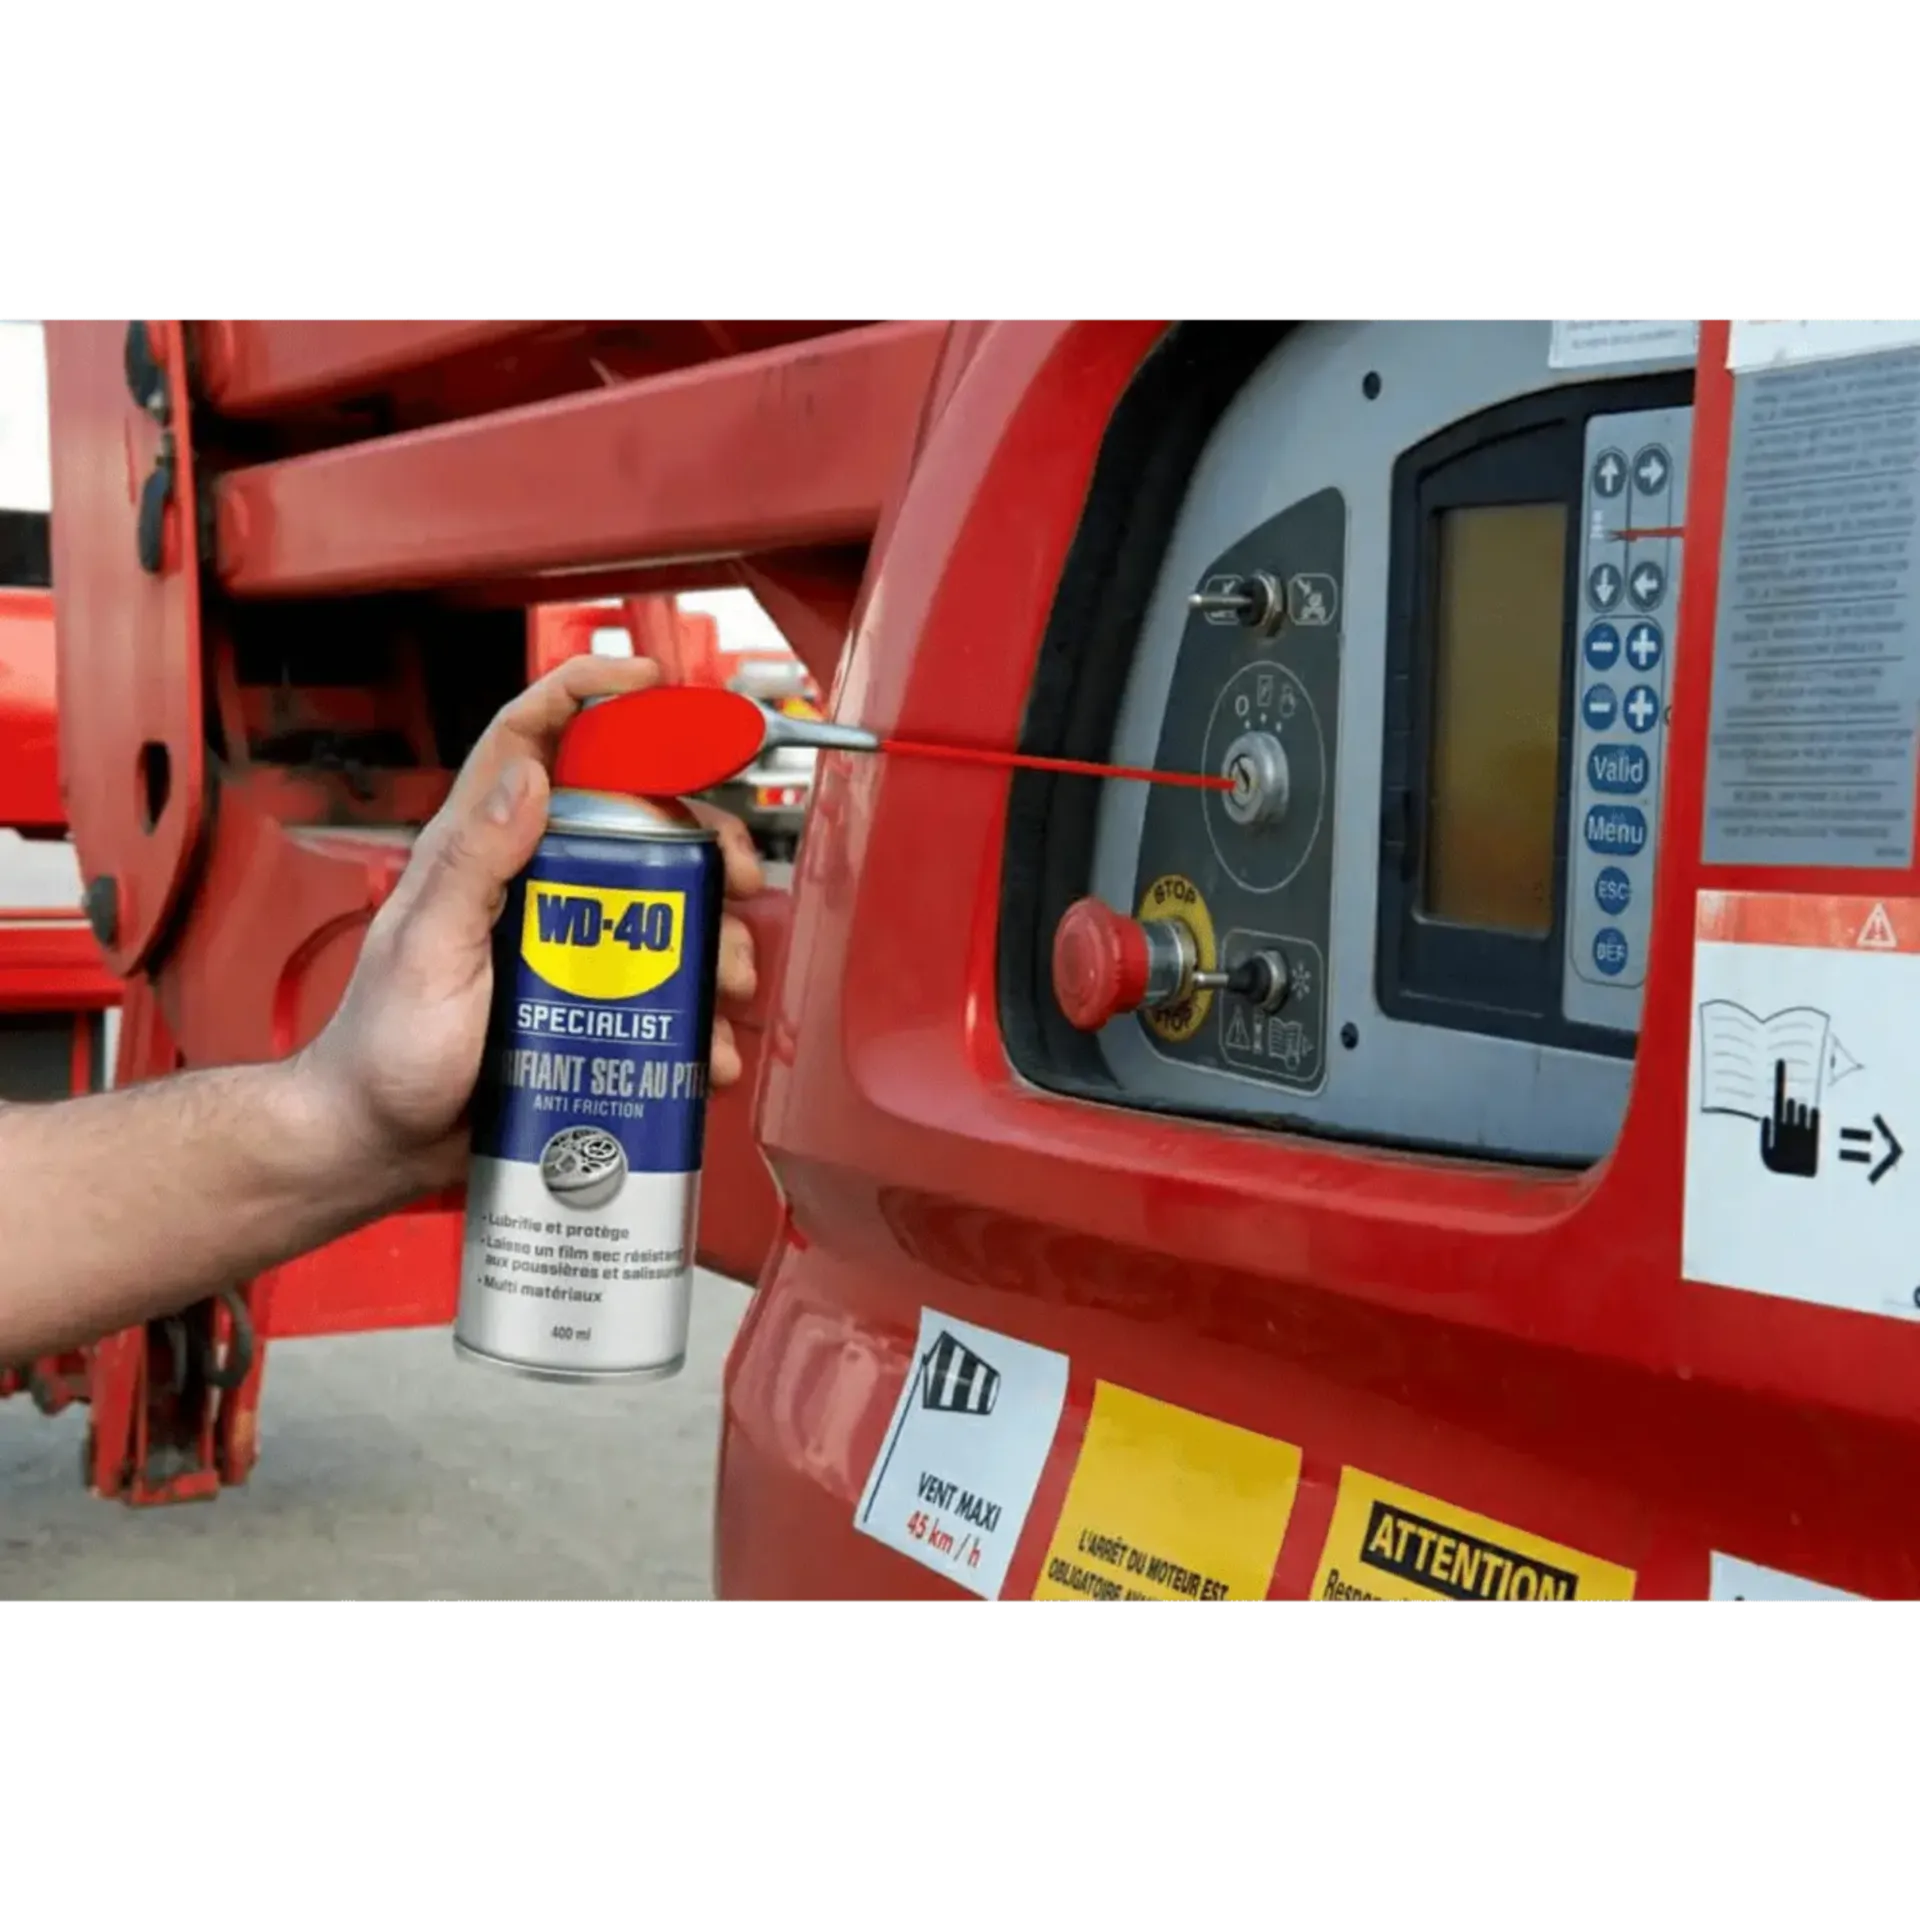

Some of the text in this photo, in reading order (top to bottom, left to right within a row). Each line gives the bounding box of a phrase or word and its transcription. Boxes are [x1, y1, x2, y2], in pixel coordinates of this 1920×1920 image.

[1593, 755, 1644, 783] Valid
[1588, 816, 1644, 844] Menu
[1154, 880, 1197, 905] STOP
[1599, 880, 1629, 900] ESC
[537, 893, 675, 953] WD-40
[517, 1003, 673, 1040] SPECIALIST
[590, 1057, 635, 1098] SEC
[639, 1059, 668, 1099] AU
[533, 1093, 644, 1118] ANTI FRICTION
[488, 1213, 630, 1241] Lubrifie et protège
[486, 1236, 530, 1255] Laisse
[534, 1244, 554, 1257] un
[558, 1245, 589, 1260] film
[592, 1249, 620, 1262] sec
[485, 1253, 508, 1268] aux
[511, 1258, 599, 1280] poussières
[602, 1267, 619, 1280] et
[483, 1275, 603, 1303] Multi matériaux
[552, 1326, 591, 1341] 400 ml
[918, 1471, 1002, 1533] VENT MAXI
[907, 1510, 929, 1540] 45
[928, 1518, 954, 1555] km
[1368, 1513, 1569, 1604] ATTENTION
[1047, 1557, 1124, 1604] OBLIGATOIRE
[1126, 1548, 1149, 1576] DU
[1145, 1555, 1202, 1598] MOTEUR
[1199, 1577, 1230, 1604] EST
